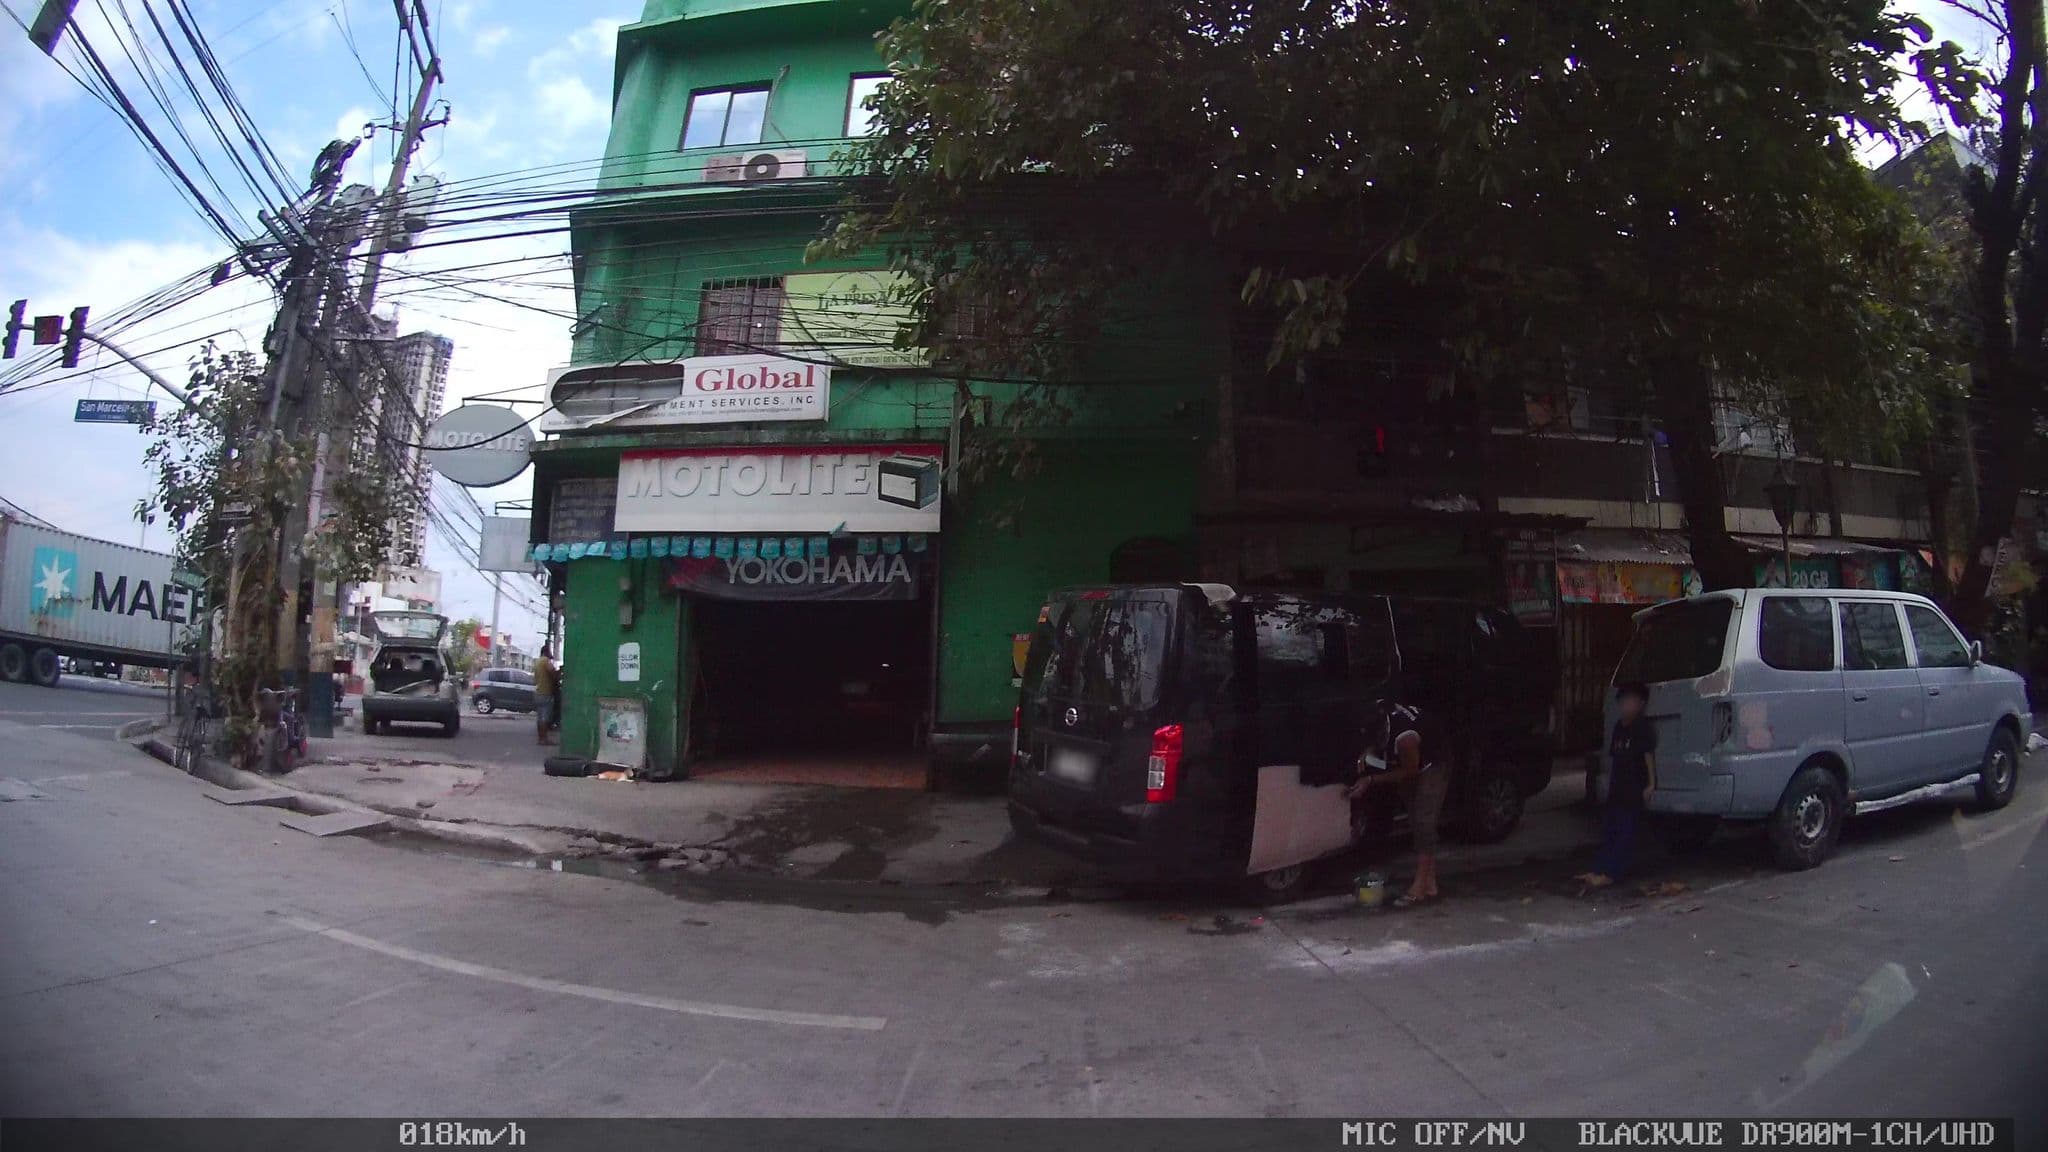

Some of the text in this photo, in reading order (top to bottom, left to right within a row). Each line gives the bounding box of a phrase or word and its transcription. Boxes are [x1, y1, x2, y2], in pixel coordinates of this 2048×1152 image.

[695, 364, 815, 392] Global
[80, 400, 96, 412] San
[626, 456, 871, 498] MOTOLITE
[725, 553, 912, 585] YOKOHAMA
